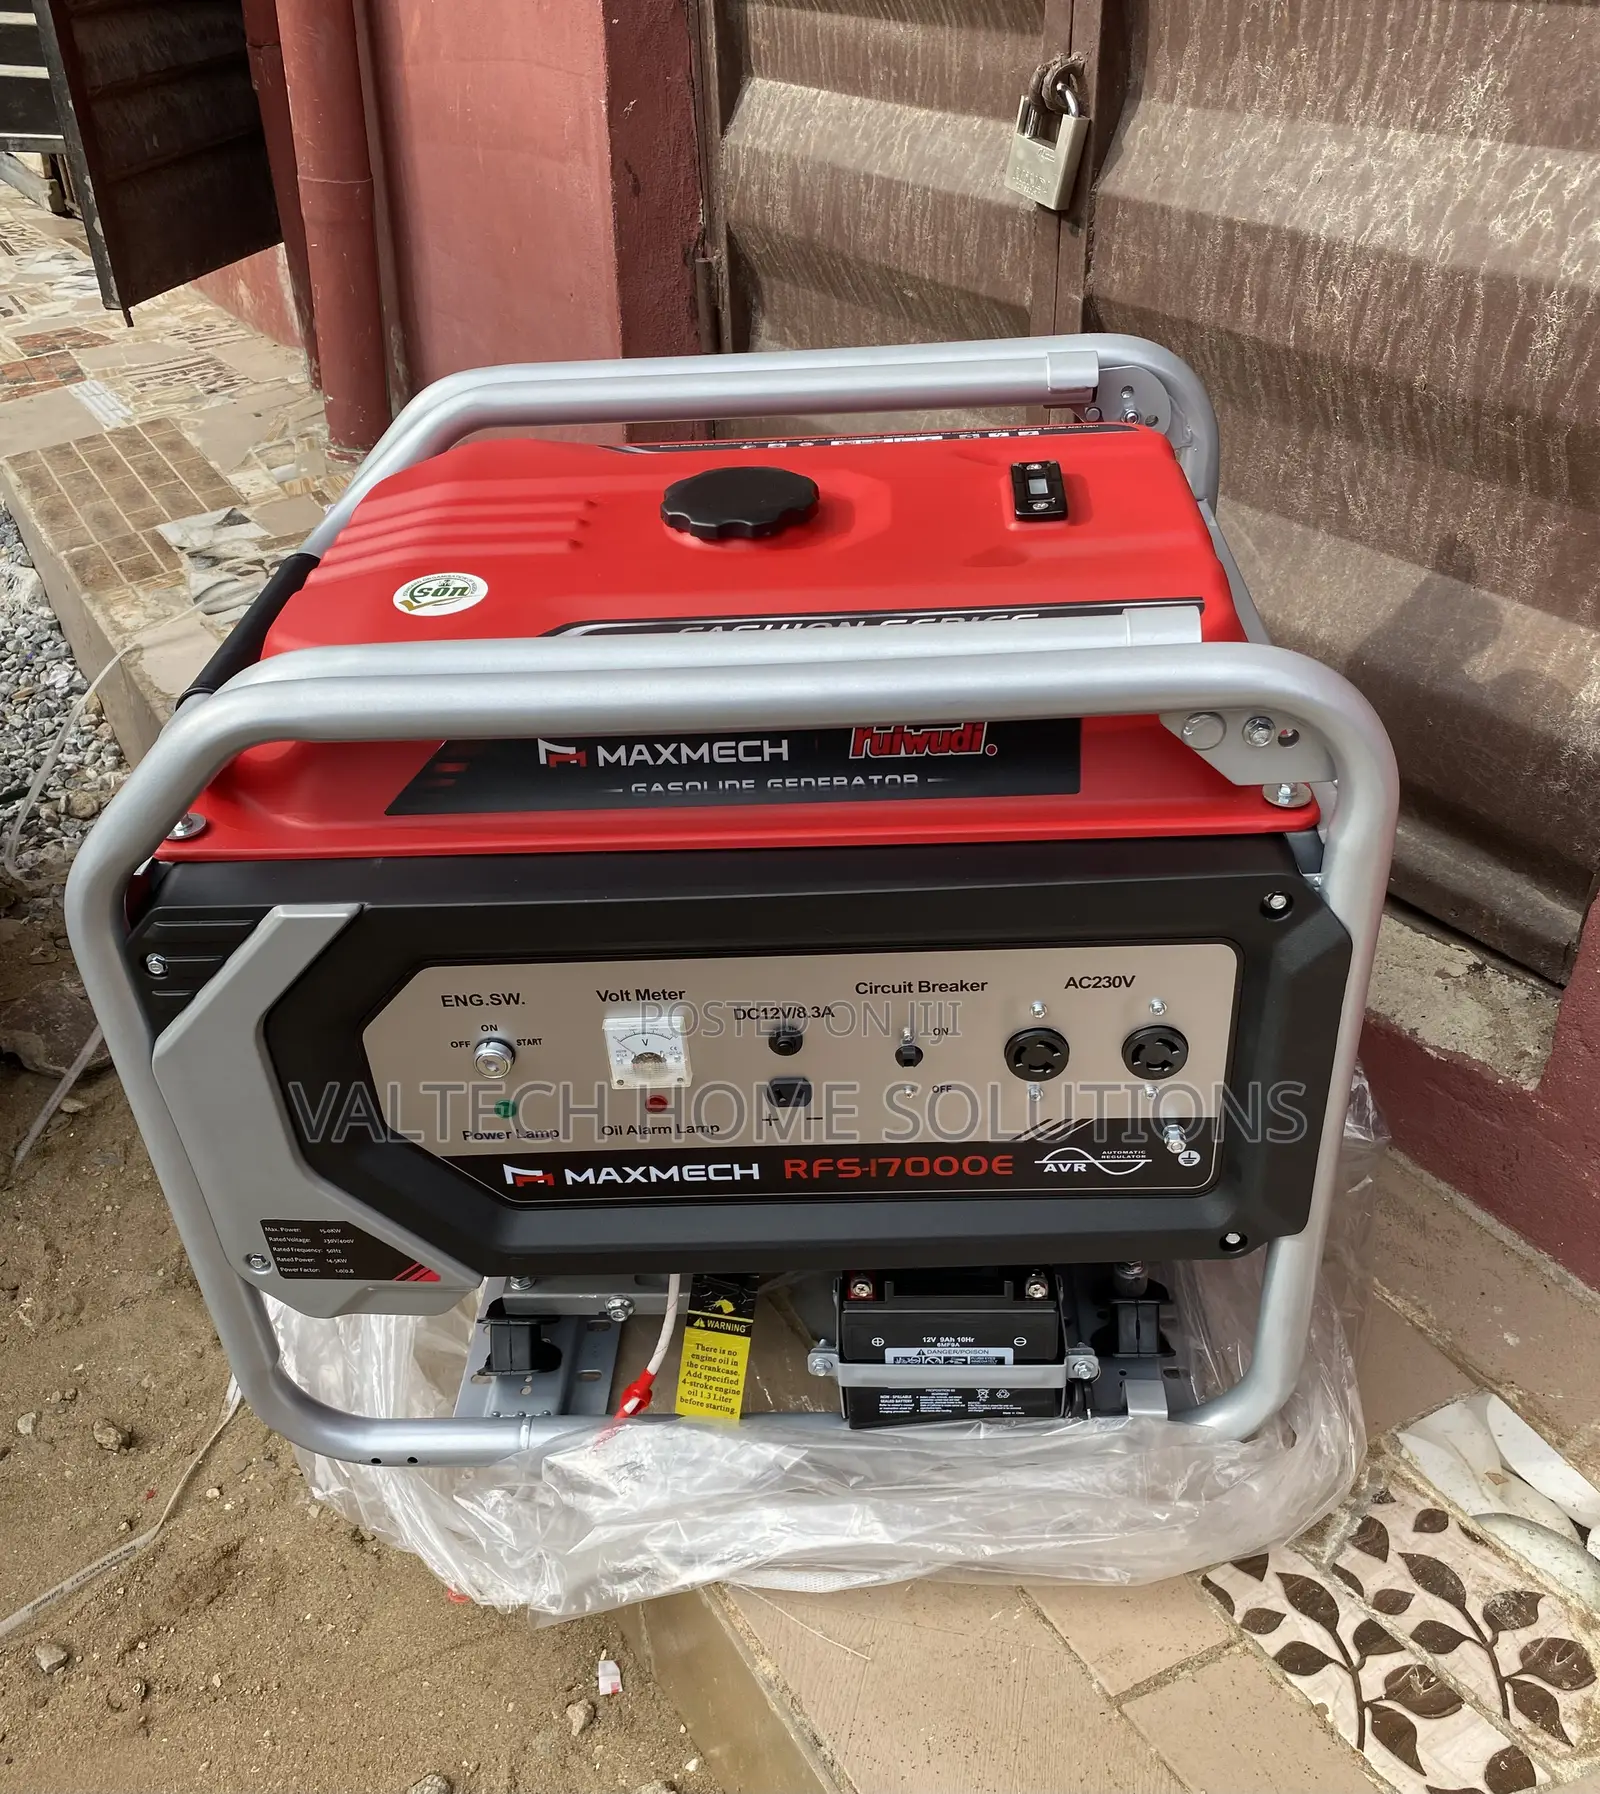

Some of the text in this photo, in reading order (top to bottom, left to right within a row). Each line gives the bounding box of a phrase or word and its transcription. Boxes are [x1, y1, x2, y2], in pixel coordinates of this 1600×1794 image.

[597, 740, 789, 767] MAXMECH
[855, 979, 988, 995] Circuit Breaker
[1064, 975, 1136, 989] AC230V
[441, 992, 526, 1007] ENG.SW.
[596, 988, 686, 1002] Volt Meter
[733, 1005, 835, 1021] DC12V/8.3A
[481, 1024, 498, 1032] ON
[932, 1027, 949, 1036] ON
[516, 1038, 542, 1046] START
[641, 1038, 649, 1047] V
[932, 1084, 952, 1093] OFF
[462, 1129, 560, 1141] Power Lamp
[601, 1123, 720, 1136] Oil Alarm Lamp
[564, 1162, 760, 1186] MAXMECH
[1043, 1163, 1087, 1173] AVR
[707, 1319, 746, 1333] WARNING
[695, 1342, 718, 1354] There
[719, 1347, 726, 1355] is
[691, 1352, 739, 1367] engine oil in
[686, 1361, 740, 1377] the crankcase.
[686, 1370, 739, 1386] Add specified
[681, 1378, 741, 1396] 4-stroke engine
[687, 1389, 732, 1404] oil 1.3 Liter
[680, 1396, 737, 1414] before starting.
